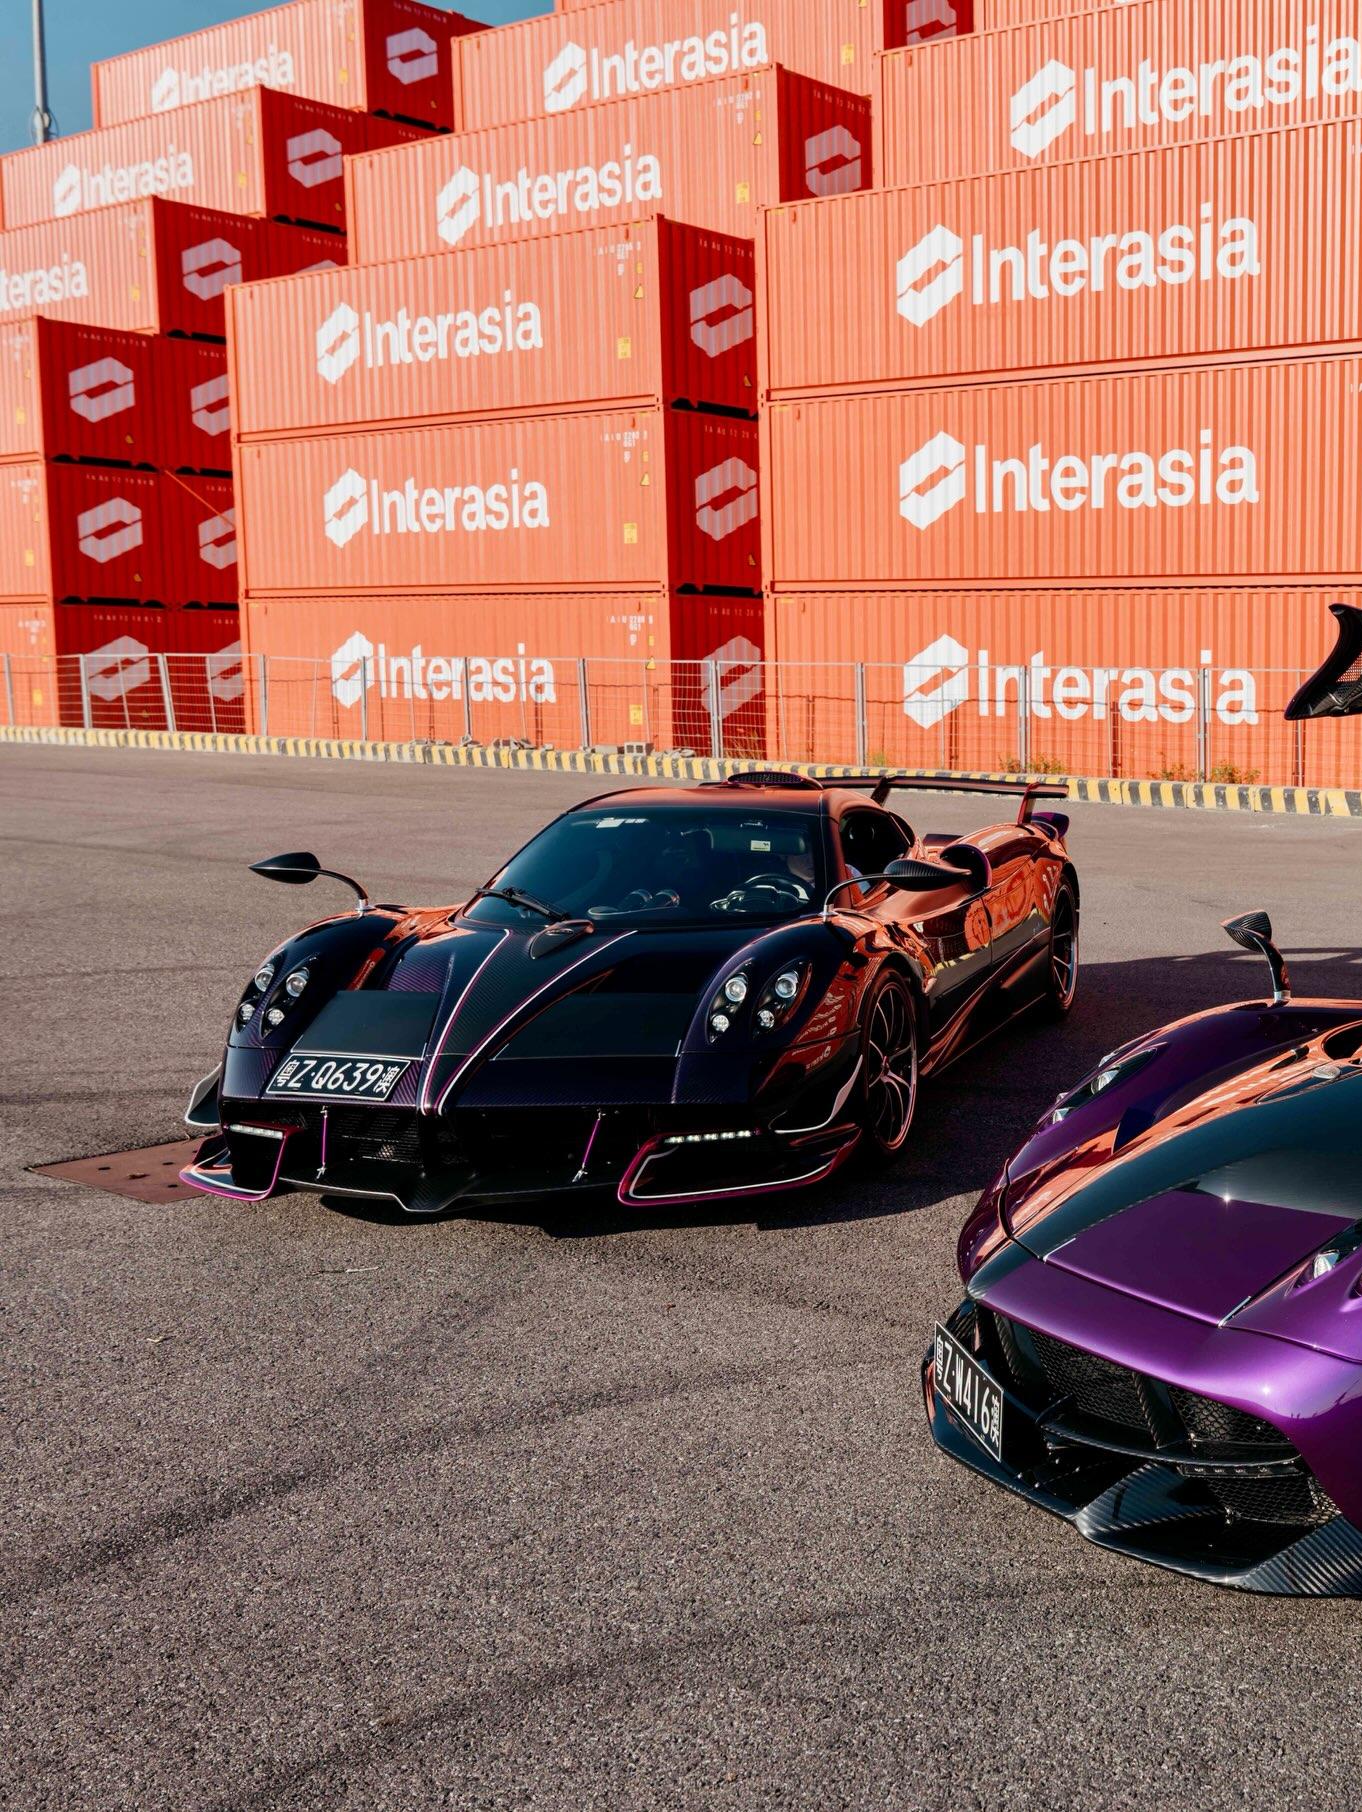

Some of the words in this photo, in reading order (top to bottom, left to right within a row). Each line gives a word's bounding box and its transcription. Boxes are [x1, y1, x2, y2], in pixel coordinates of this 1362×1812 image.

[181, 44, 294, 103] Interasia
[585, 13, 769, 99] Interasia
[83, 144, 194, 208] Interasia
[484, 144, 662, 228] Interasia
[973, 202, 1260, 305] Interasia
[364, 290, 543, 368] Interasia
[372, 469, 550, 534] Interasia
[976, 429, 1259, 513] Interasia
[379, 643, 556, 703] Interasia
[978, 650, 1259, 725] Interasia
